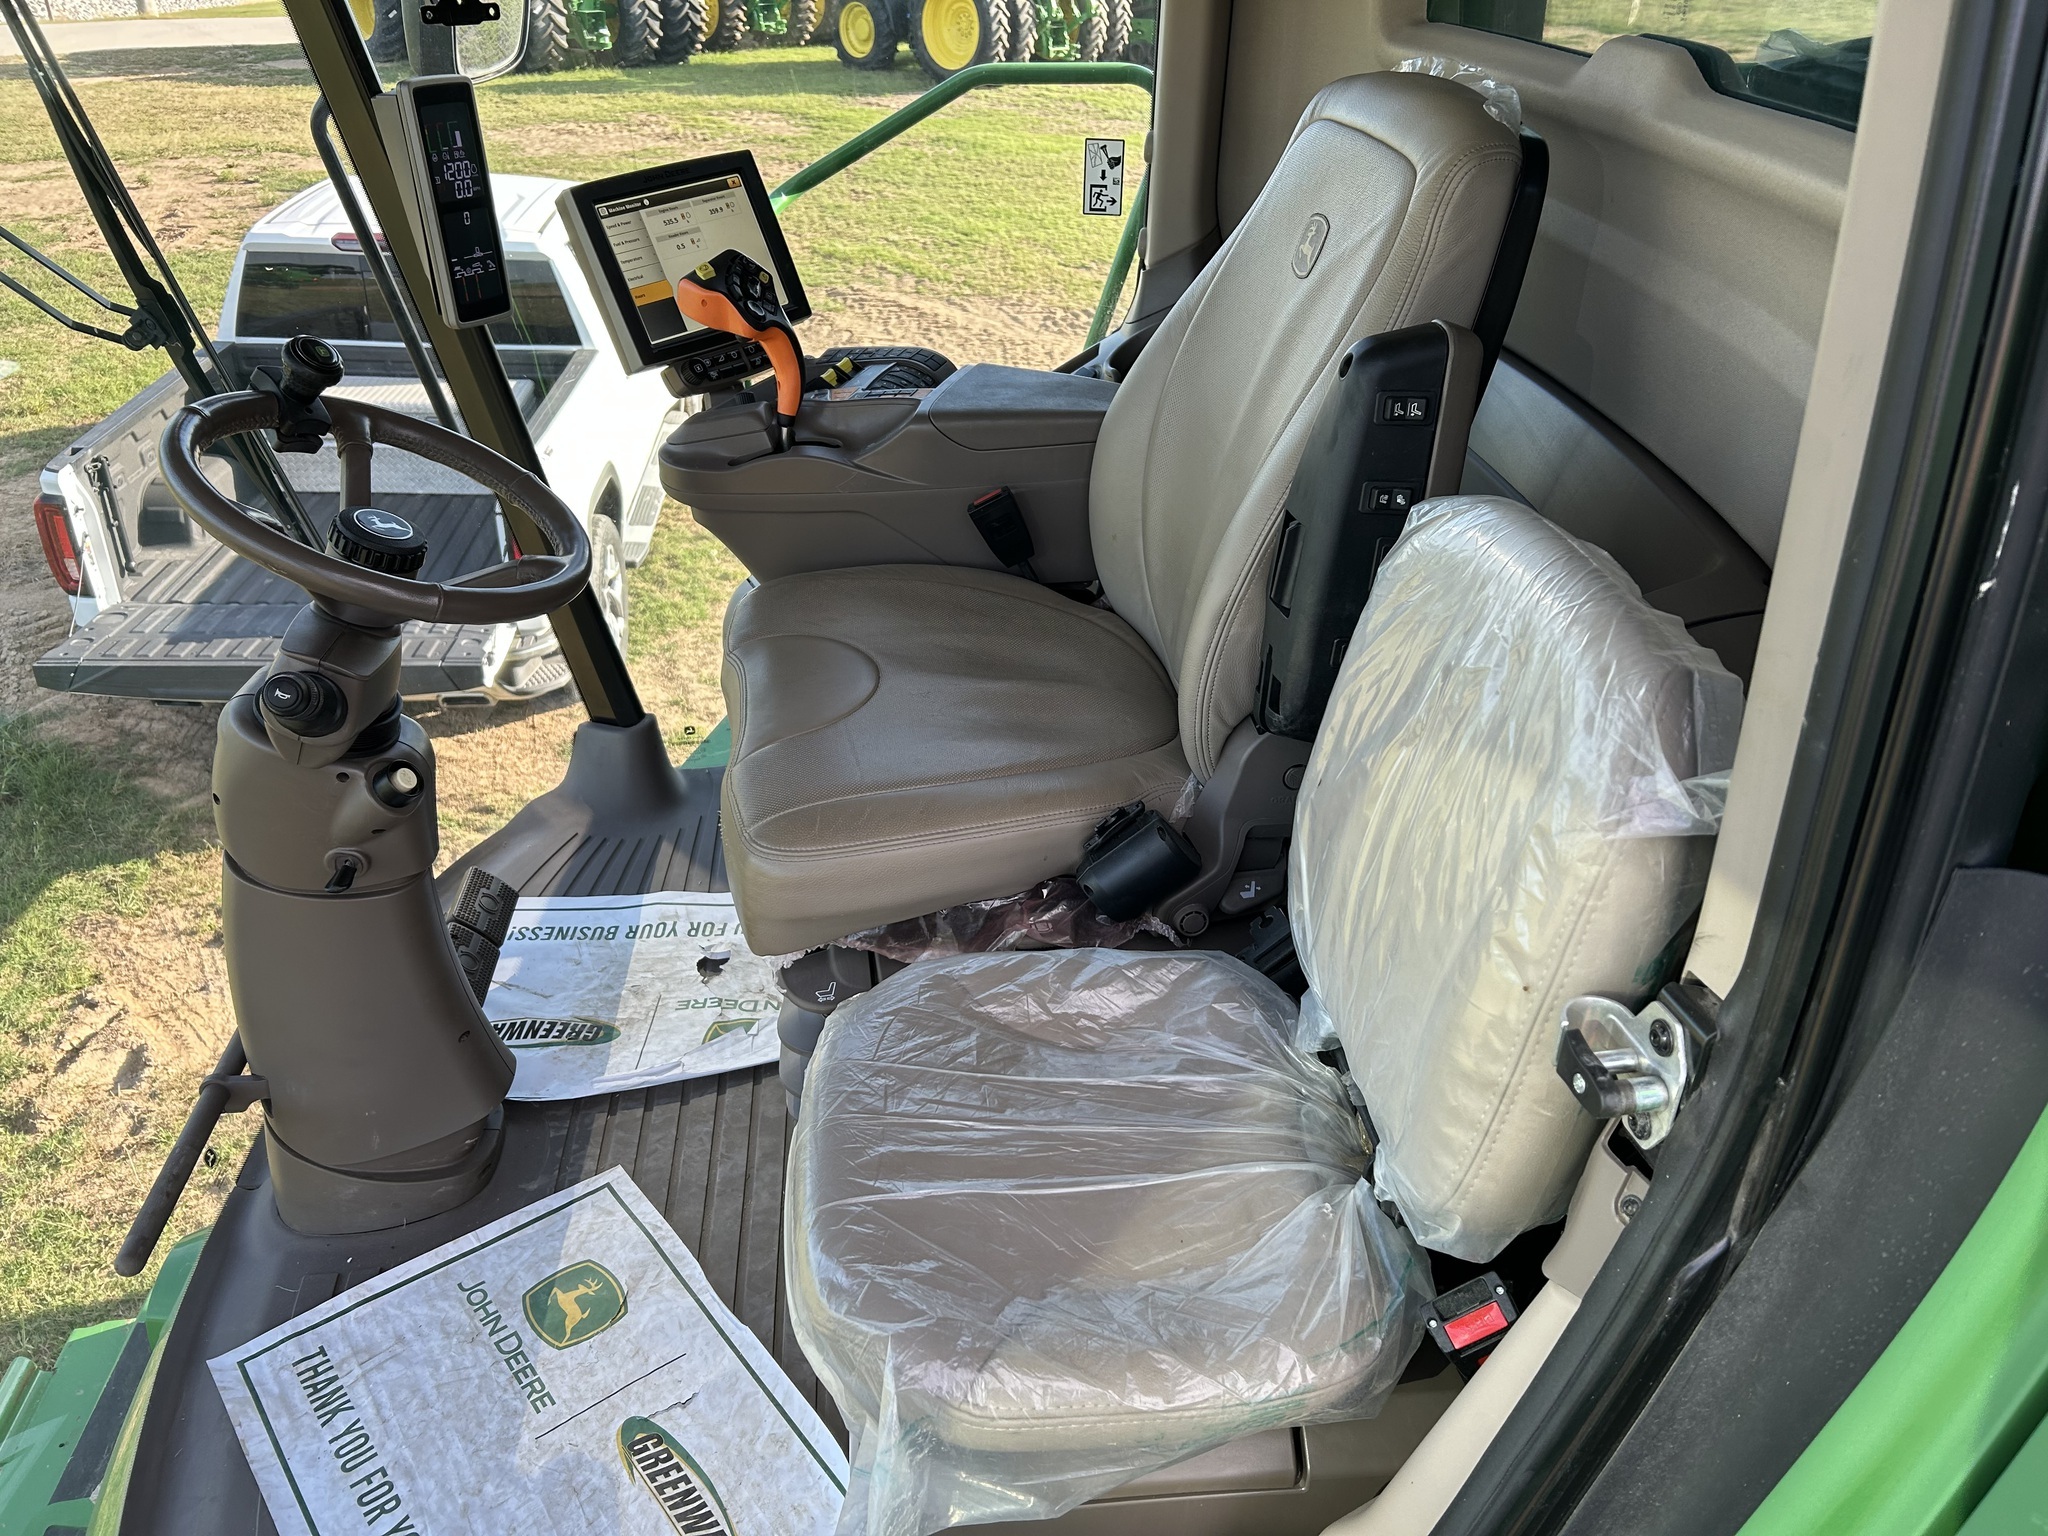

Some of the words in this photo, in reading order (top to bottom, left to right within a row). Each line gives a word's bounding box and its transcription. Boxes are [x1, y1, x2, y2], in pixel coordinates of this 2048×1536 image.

[443, 160, 472, 181] 1200
[454, 179, 474, 199] 0.0
[463, 211, 471, 225] 0
[608, 205, 625, 213] Machine
[663, 217, 679, 227] 535.5
[676, 242, 687, 251] 0.5
[620, 256, 643, 265] Temperature
[507, 924, 620, 942] BUSINESS!
[625, 921, 678, 940] YOUR
[687, 921, 729, 938] FOR
[675, 998, 758, 1012] DEERE
[492, 1020, 601, 1042] GREENWA
[457, 1280, 507, 1337] JOHN
[494, 1330, 557, 1414] DEERE
[291, 1345, 355, 1429] THANK
[328, 1417, 378, 1474] YOU
[626, 1432, 729, 1536] GREENW
[349, 1465, 402, 1527] FOR
